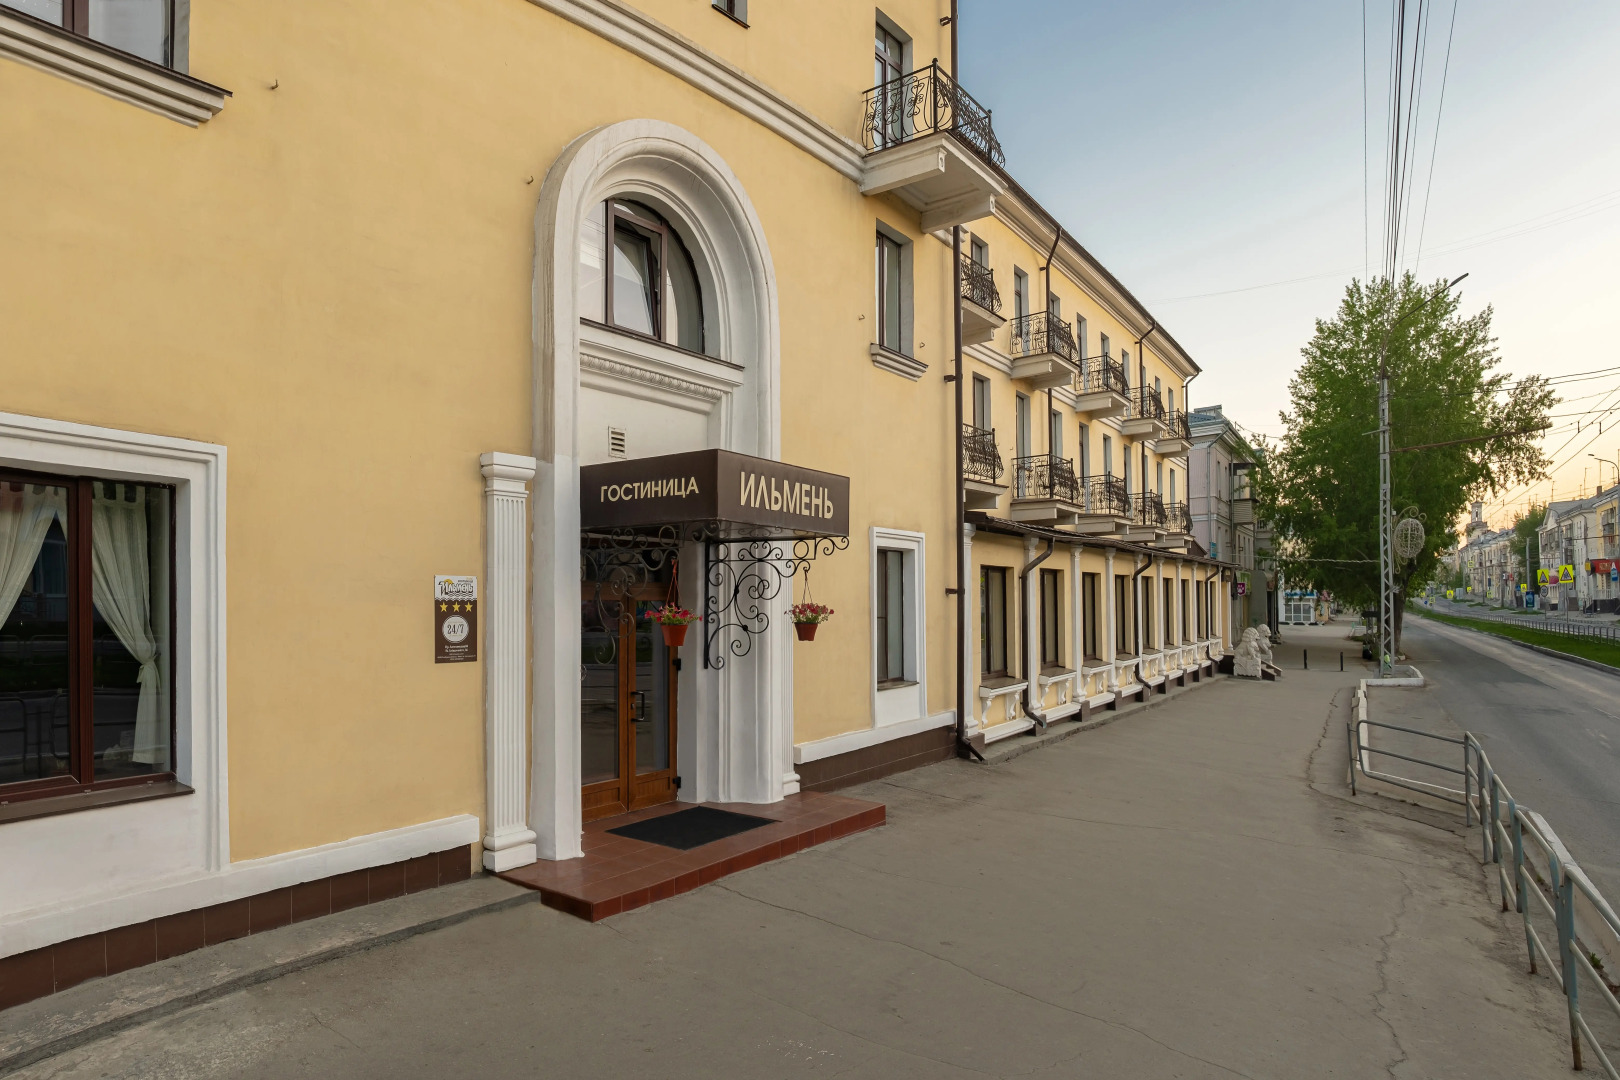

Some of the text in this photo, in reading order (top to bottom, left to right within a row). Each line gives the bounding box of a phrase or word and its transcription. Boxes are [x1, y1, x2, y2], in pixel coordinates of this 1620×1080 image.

[600, 476, 700, 503] ГОСТИНИЦА
[740, 471, 834, 520] ИЛЬМЕНЬ
[447, 624, 464, 635] 24/7
